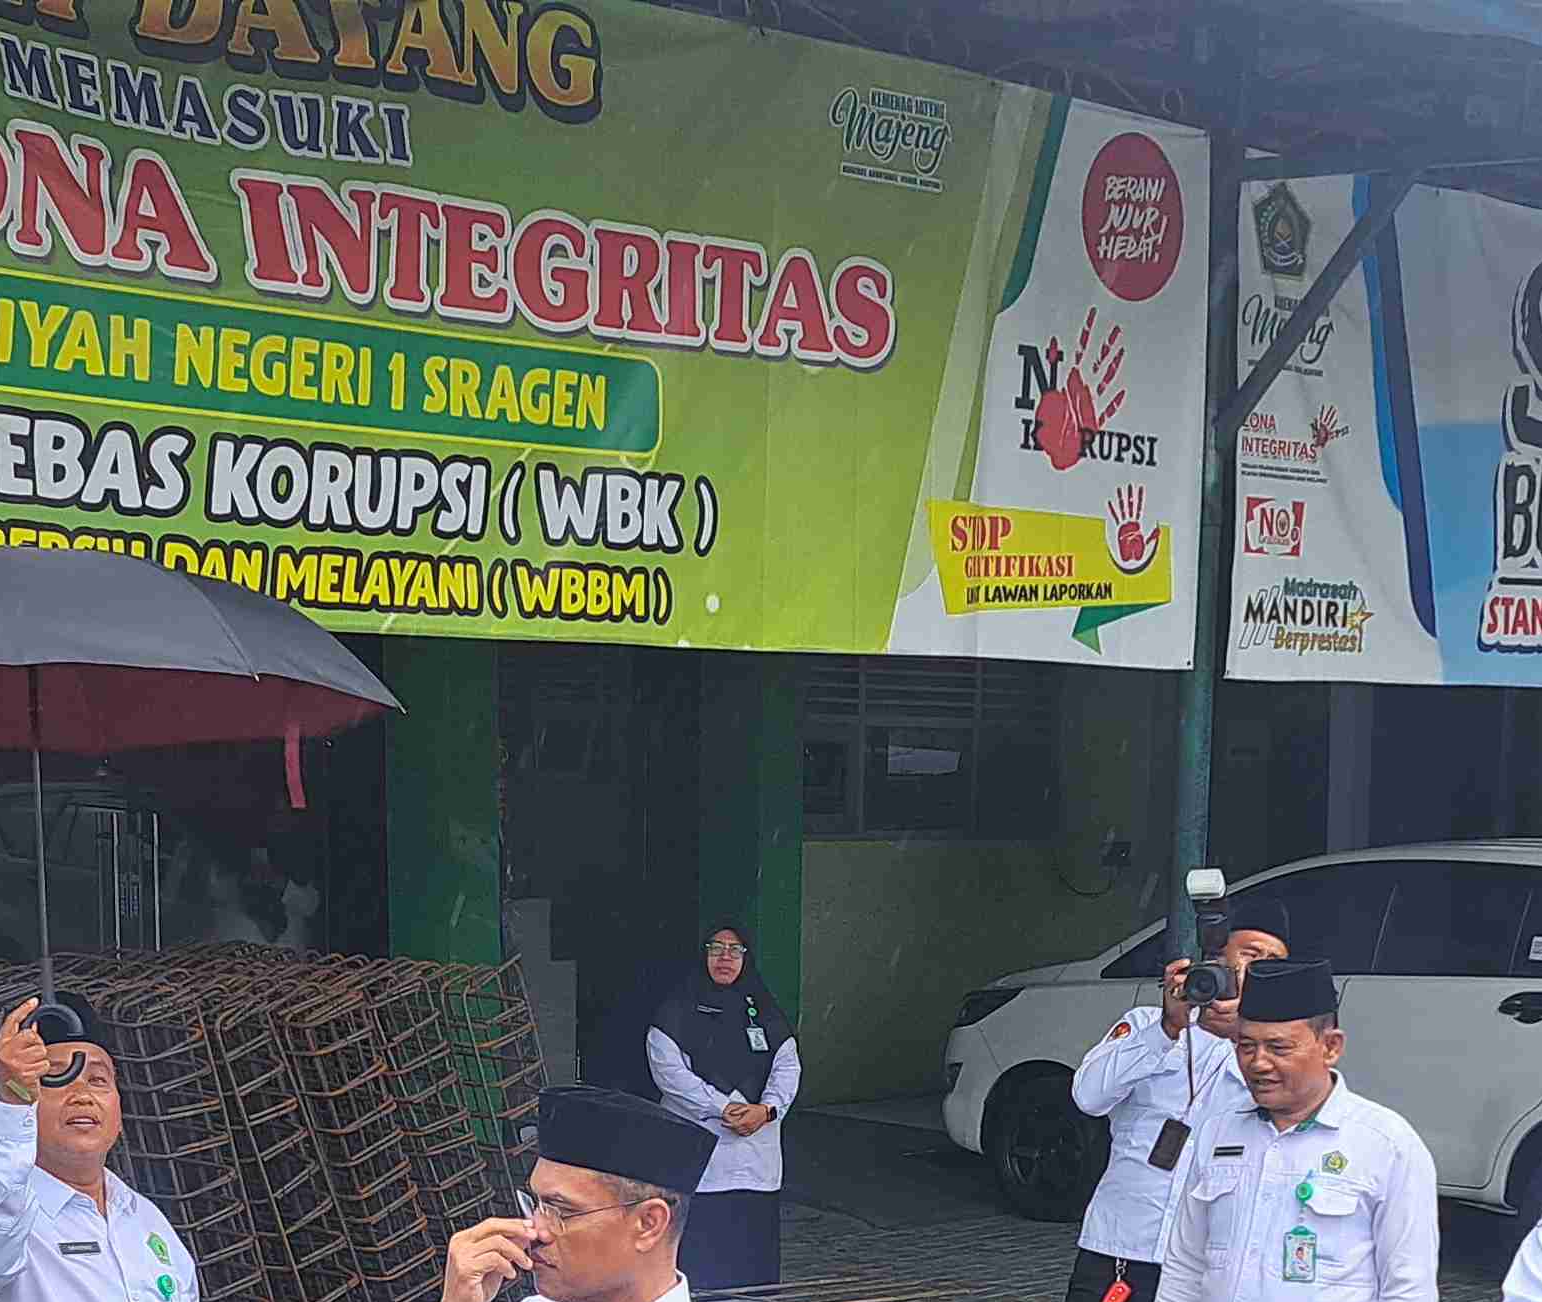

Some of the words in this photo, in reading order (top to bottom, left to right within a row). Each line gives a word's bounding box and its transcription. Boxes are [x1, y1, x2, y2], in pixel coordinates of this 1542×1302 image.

[829, 88, 949, 176] Majeng
[1105, 176, 1165, 201] BERANI
[1099, 203, 1159, 235] JUJUR
[231, 170, 895, 370] INTEGRITAS
[175, 326, 370, 407] NEGERI
[388, 358, 405, 411] 1
[424, 358, 606, 431] SRAGEN
[1020, 419, 1158, 467] KRUPSI
[1242, 437, 1317, 460] INTEGRITAS
[211, 442, 485, 535] KORUPSI
[276, 551, 479, 610] MELAYANI
[985, 583, 1038, 603] LAWAN
[1044, 582, 1113, 601] LAPORKAN
[1283, 577, 1358, 600] Madrasah
[1244, 595, 1347, 628] MANDIRI
